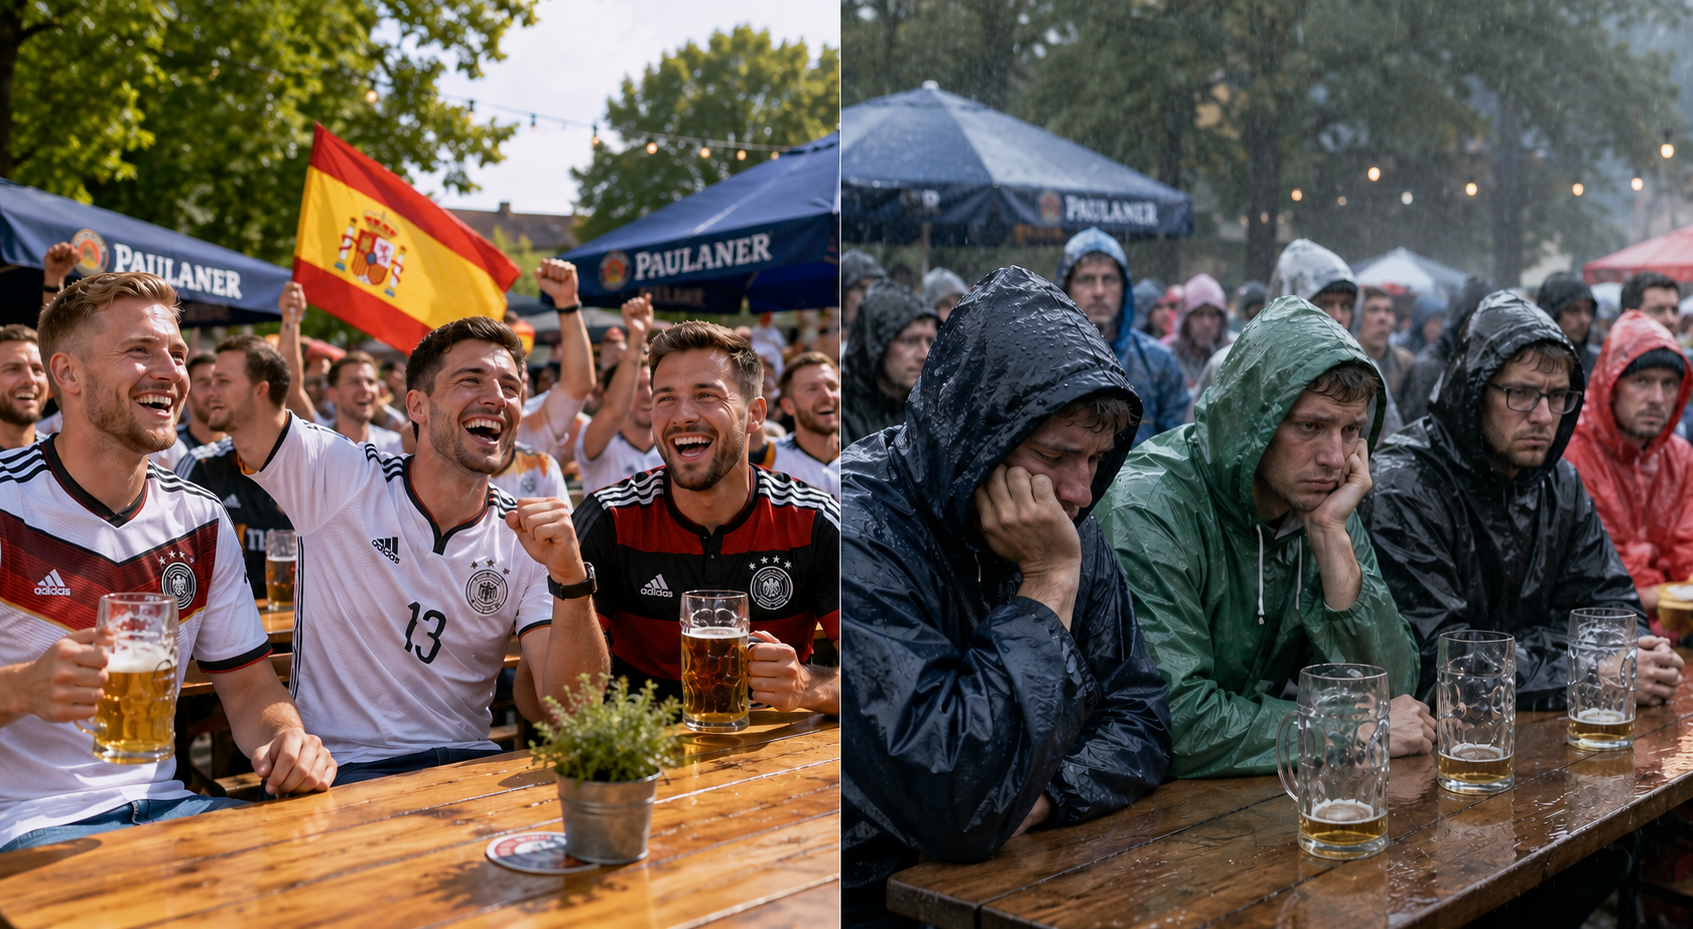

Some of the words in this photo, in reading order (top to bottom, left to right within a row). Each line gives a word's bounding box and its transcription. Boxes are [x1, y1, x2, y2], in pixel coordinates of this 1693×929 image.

[1064, 194, 1160, 227] PAULANER
[113, 243, 243, 300] PAULANER
[634, 232, 773, 281] PAULANER
[371, 539, 401, 565] adidas
[33, 585, 71, 596] adidas
[640, 587, 674, 598] adidas
[404, 601, 447, 665] 13
